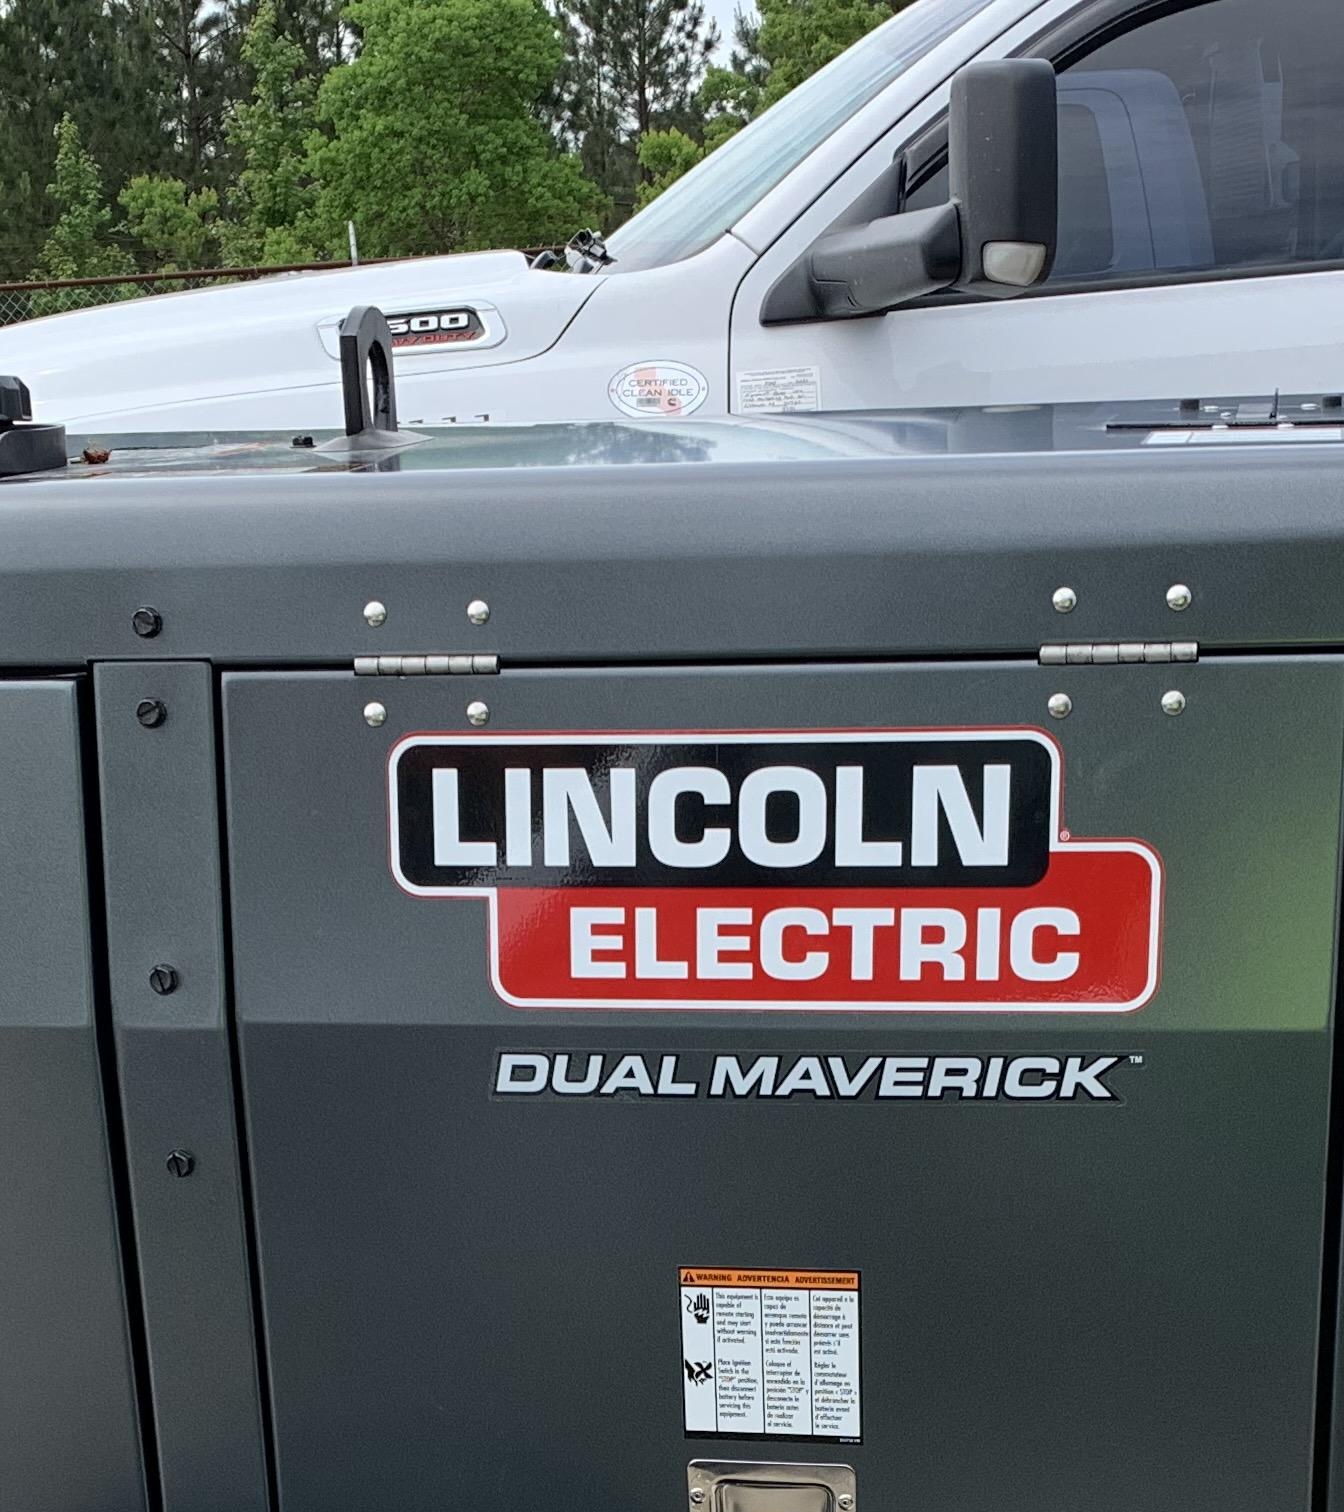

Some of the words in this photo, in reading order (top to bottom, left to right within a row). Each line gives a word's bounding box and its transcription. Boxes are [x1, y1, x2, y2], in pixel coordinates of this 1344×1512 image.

[387, 313, 469, 334] 500
[623, 388, 662, 397] CLEAN
[667, 388, 694, 397] IDLE
[628, 378, 688, 387] CERTIFIED
[431, 764, 1012, 868] LINCOLN
[569, 906, 1081, 981] ELECTRIC
[496, 1053, 698, 1096] DUAL
[709, 1056, 1118, 1099] MAVERICK
[737, 1275, 789, 1283] ADVERTENCIA
